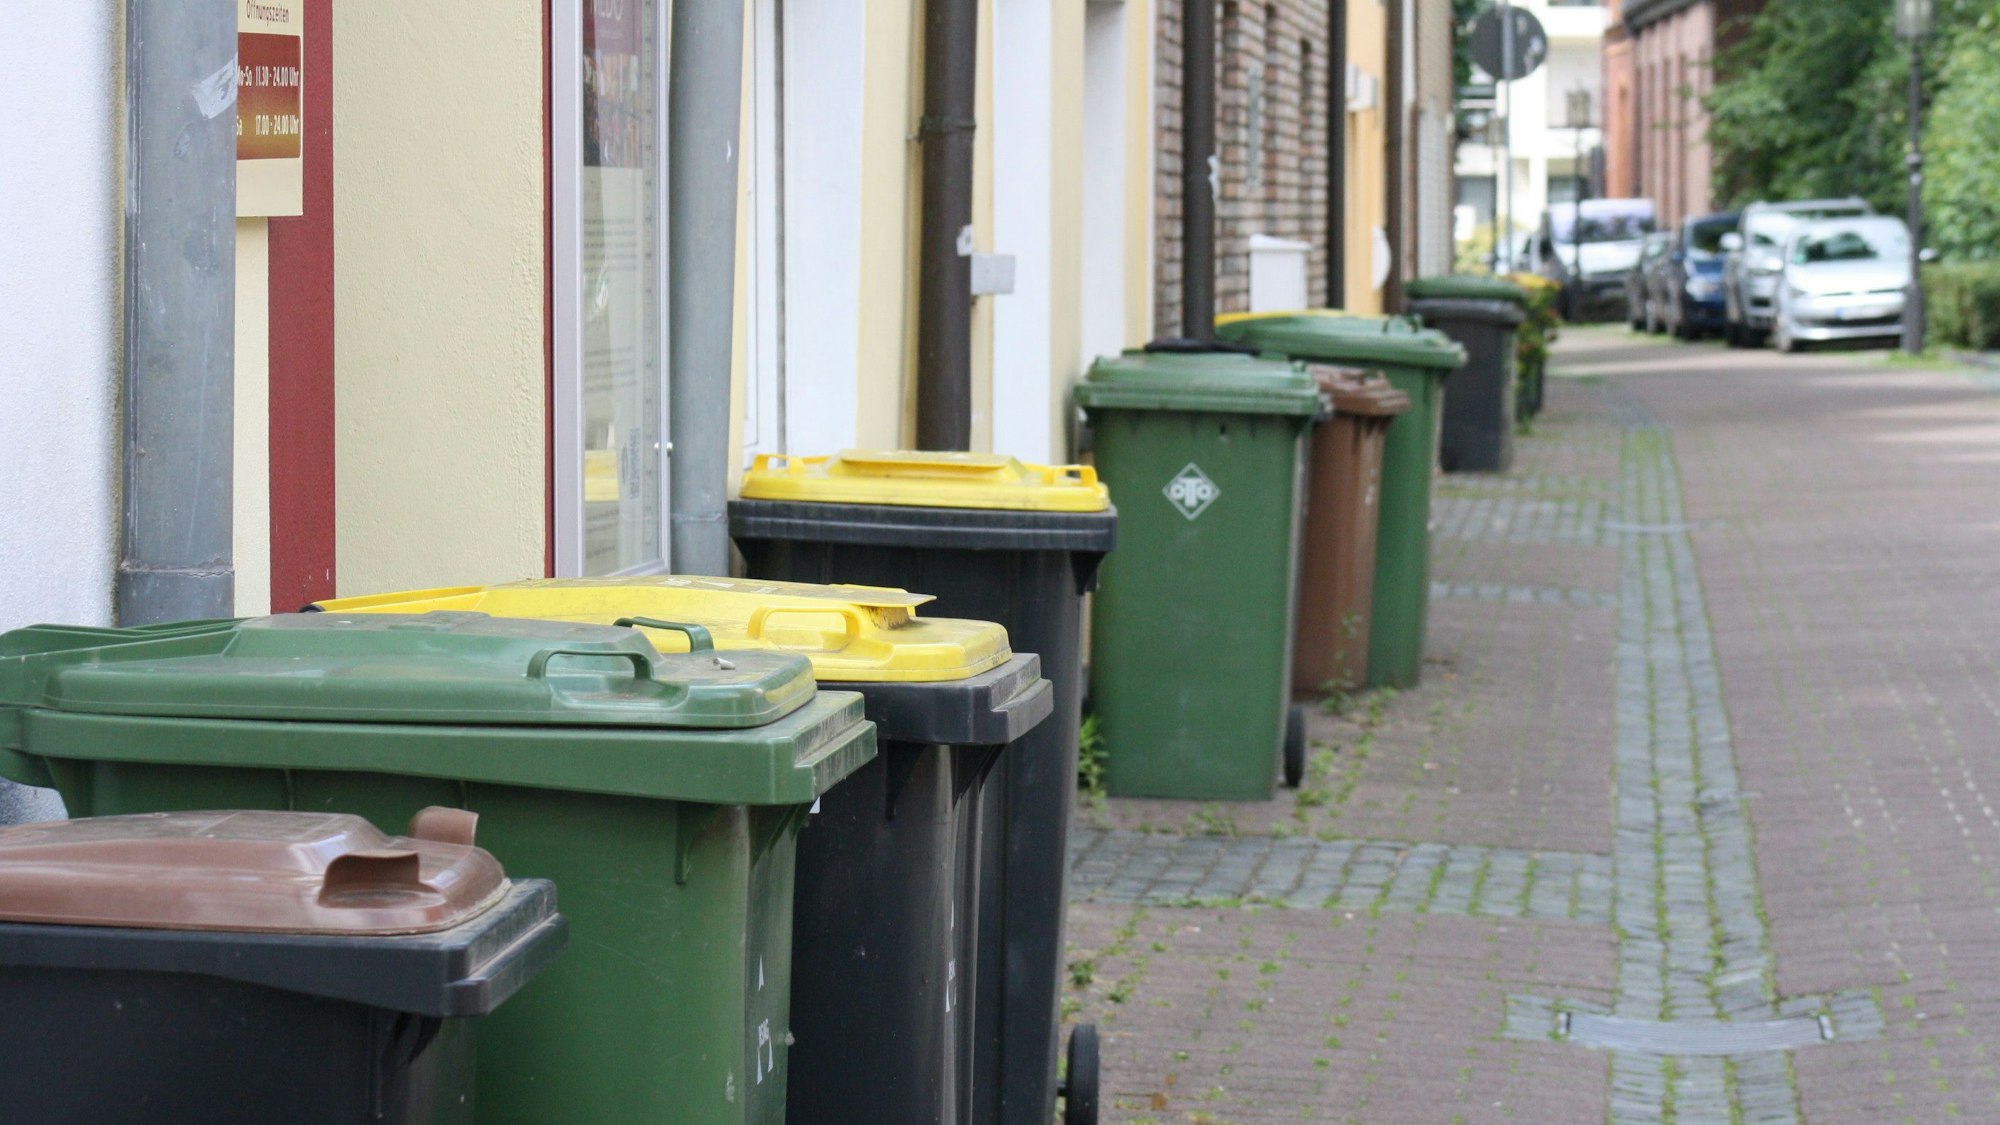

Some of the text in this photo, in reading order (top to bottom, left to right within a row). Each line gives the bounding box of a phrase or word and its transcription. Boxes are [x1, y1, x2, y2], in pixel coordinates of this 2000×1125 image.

[256, 65, 269, 86] 11.30
[273, 66, 288, 87] 24.00
[289, 67, 299, 87] Uhr
[256, 114, 269, 135] 17.00
[274, 114, 289, 135] 24.00
[289, 114, 299, 135] Uhr
